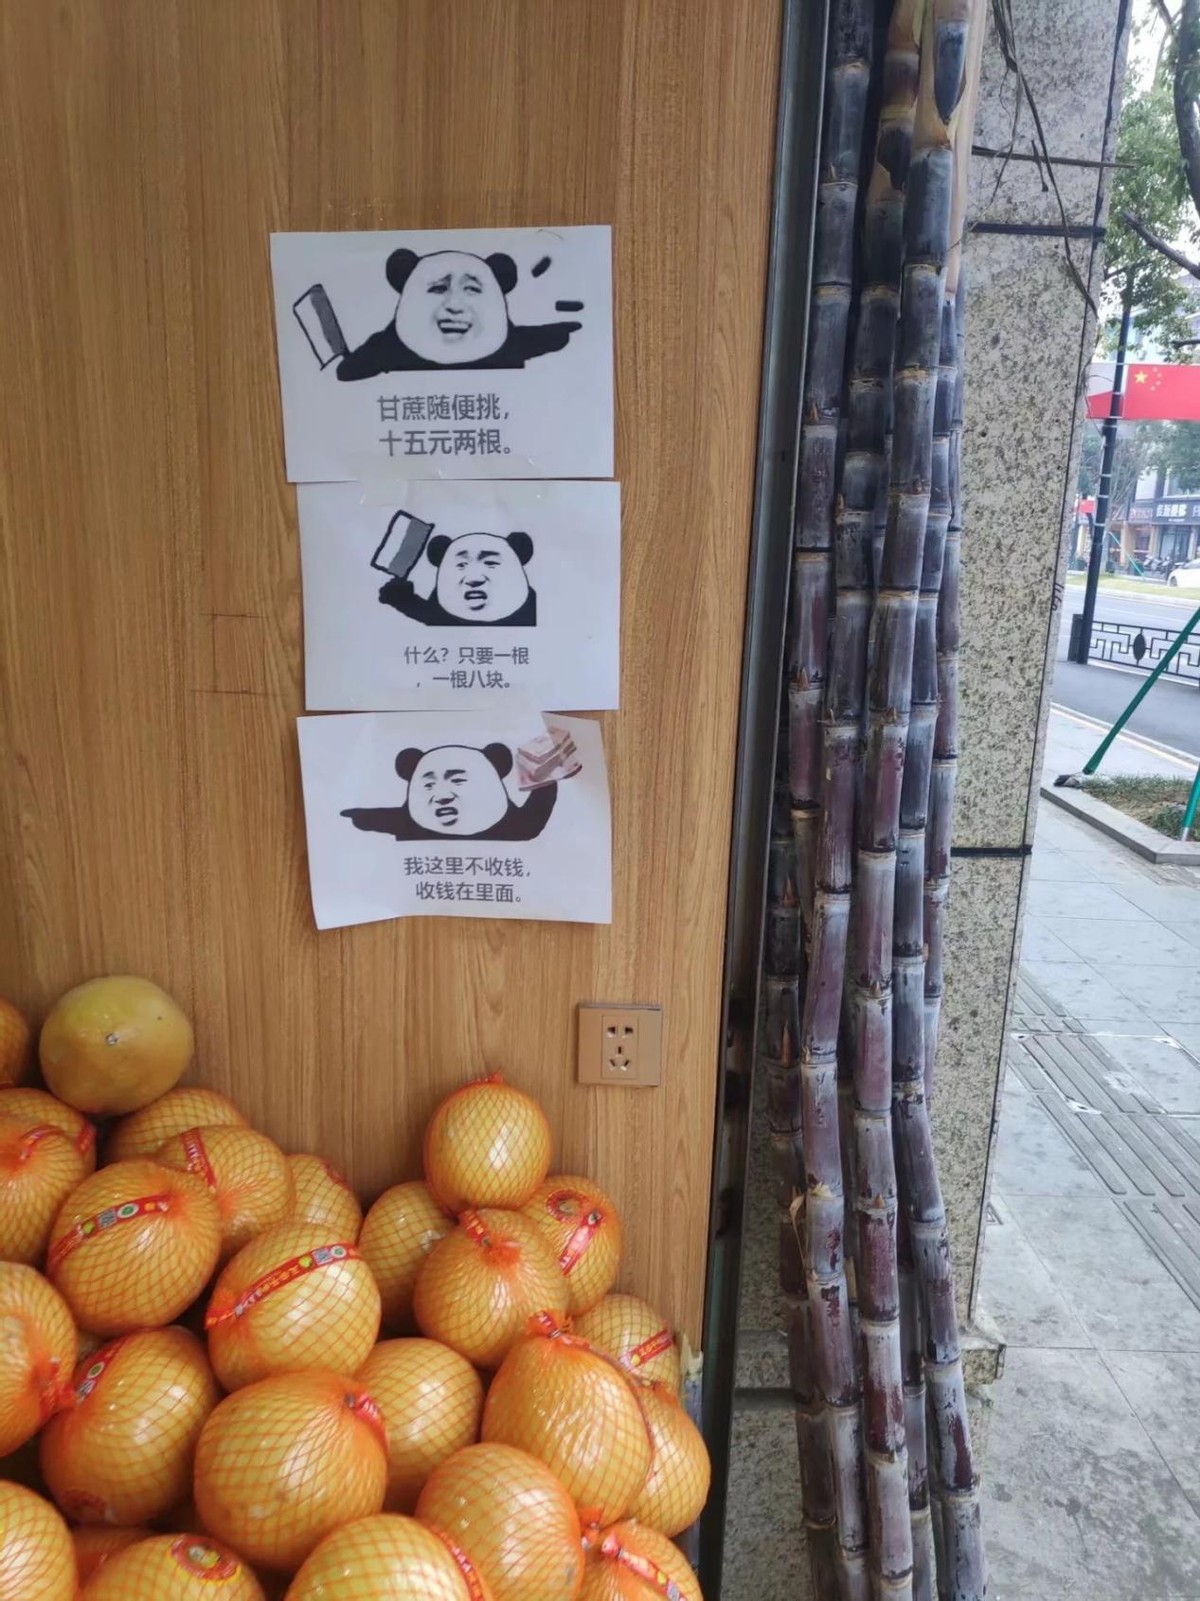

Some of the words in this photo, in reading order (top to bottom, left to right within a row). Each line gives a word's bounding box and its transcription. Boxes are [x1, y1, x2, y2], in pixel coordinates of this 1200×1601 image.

[377, 393, 509, 422] 甘蔗随便挑，
[378, 428, 511, 457] 十五元两根。
[404, 646, 530, 665] 什么？只要一根
[403, 856, 531, 877] 我这里不收钱，
[415, 881, 521, 903] 收钱在里面。
